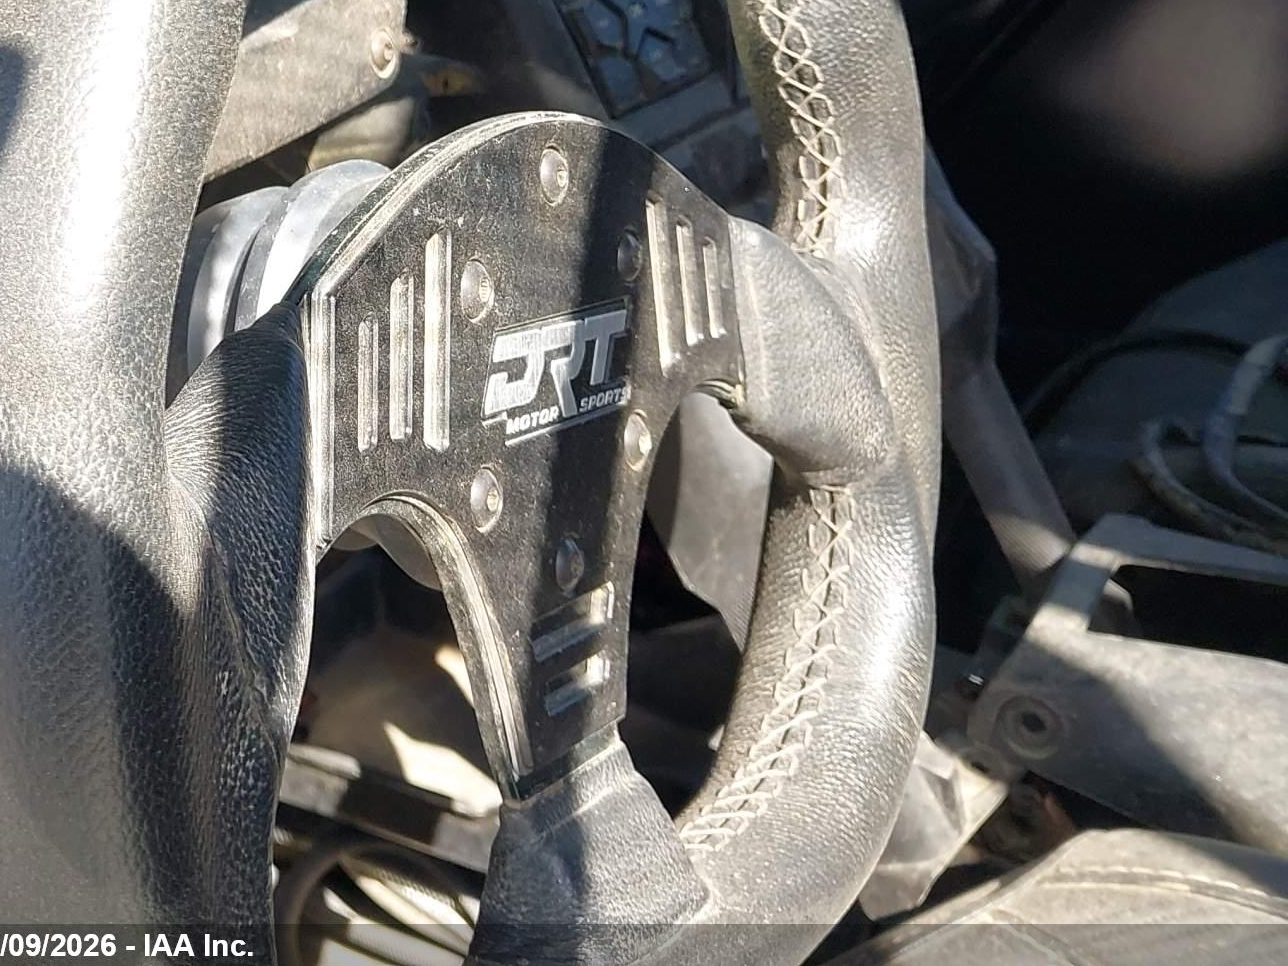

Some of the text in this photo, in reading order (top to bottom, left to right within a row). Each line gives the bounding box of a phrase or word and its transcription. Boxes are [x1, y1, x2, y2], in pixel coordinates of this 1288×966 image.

[484, 309, 628, 418] DRT
[505, 384, 631, 434] MOTOR SPORTS
